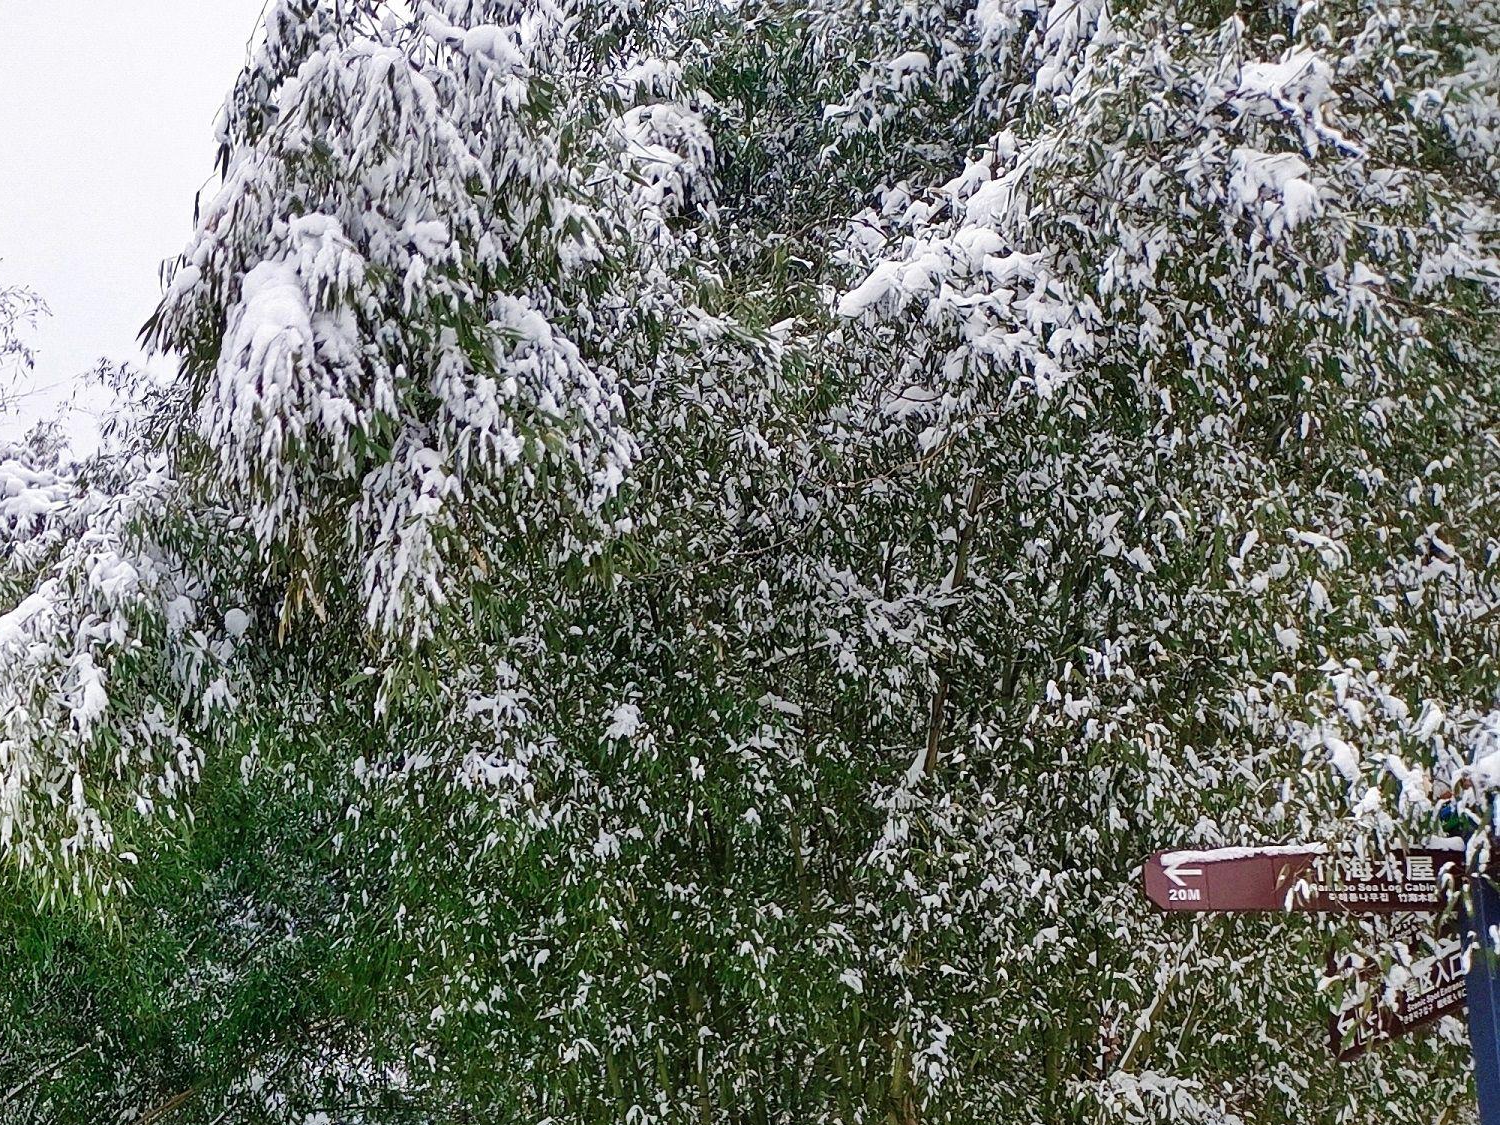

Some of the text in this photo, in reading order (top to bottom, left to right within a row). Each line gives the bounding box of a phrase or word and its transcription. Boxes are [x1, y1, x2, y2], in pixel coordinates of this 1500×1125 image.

[1311, 855, 1436, 883] 竹海木屋
[1168, 888, 1201, 901] 20M
[1358, 883, 1379, 892] Sea
[1381, 883, 1402, 894] Log
[1405, 883, 1437, 892] Cabin
